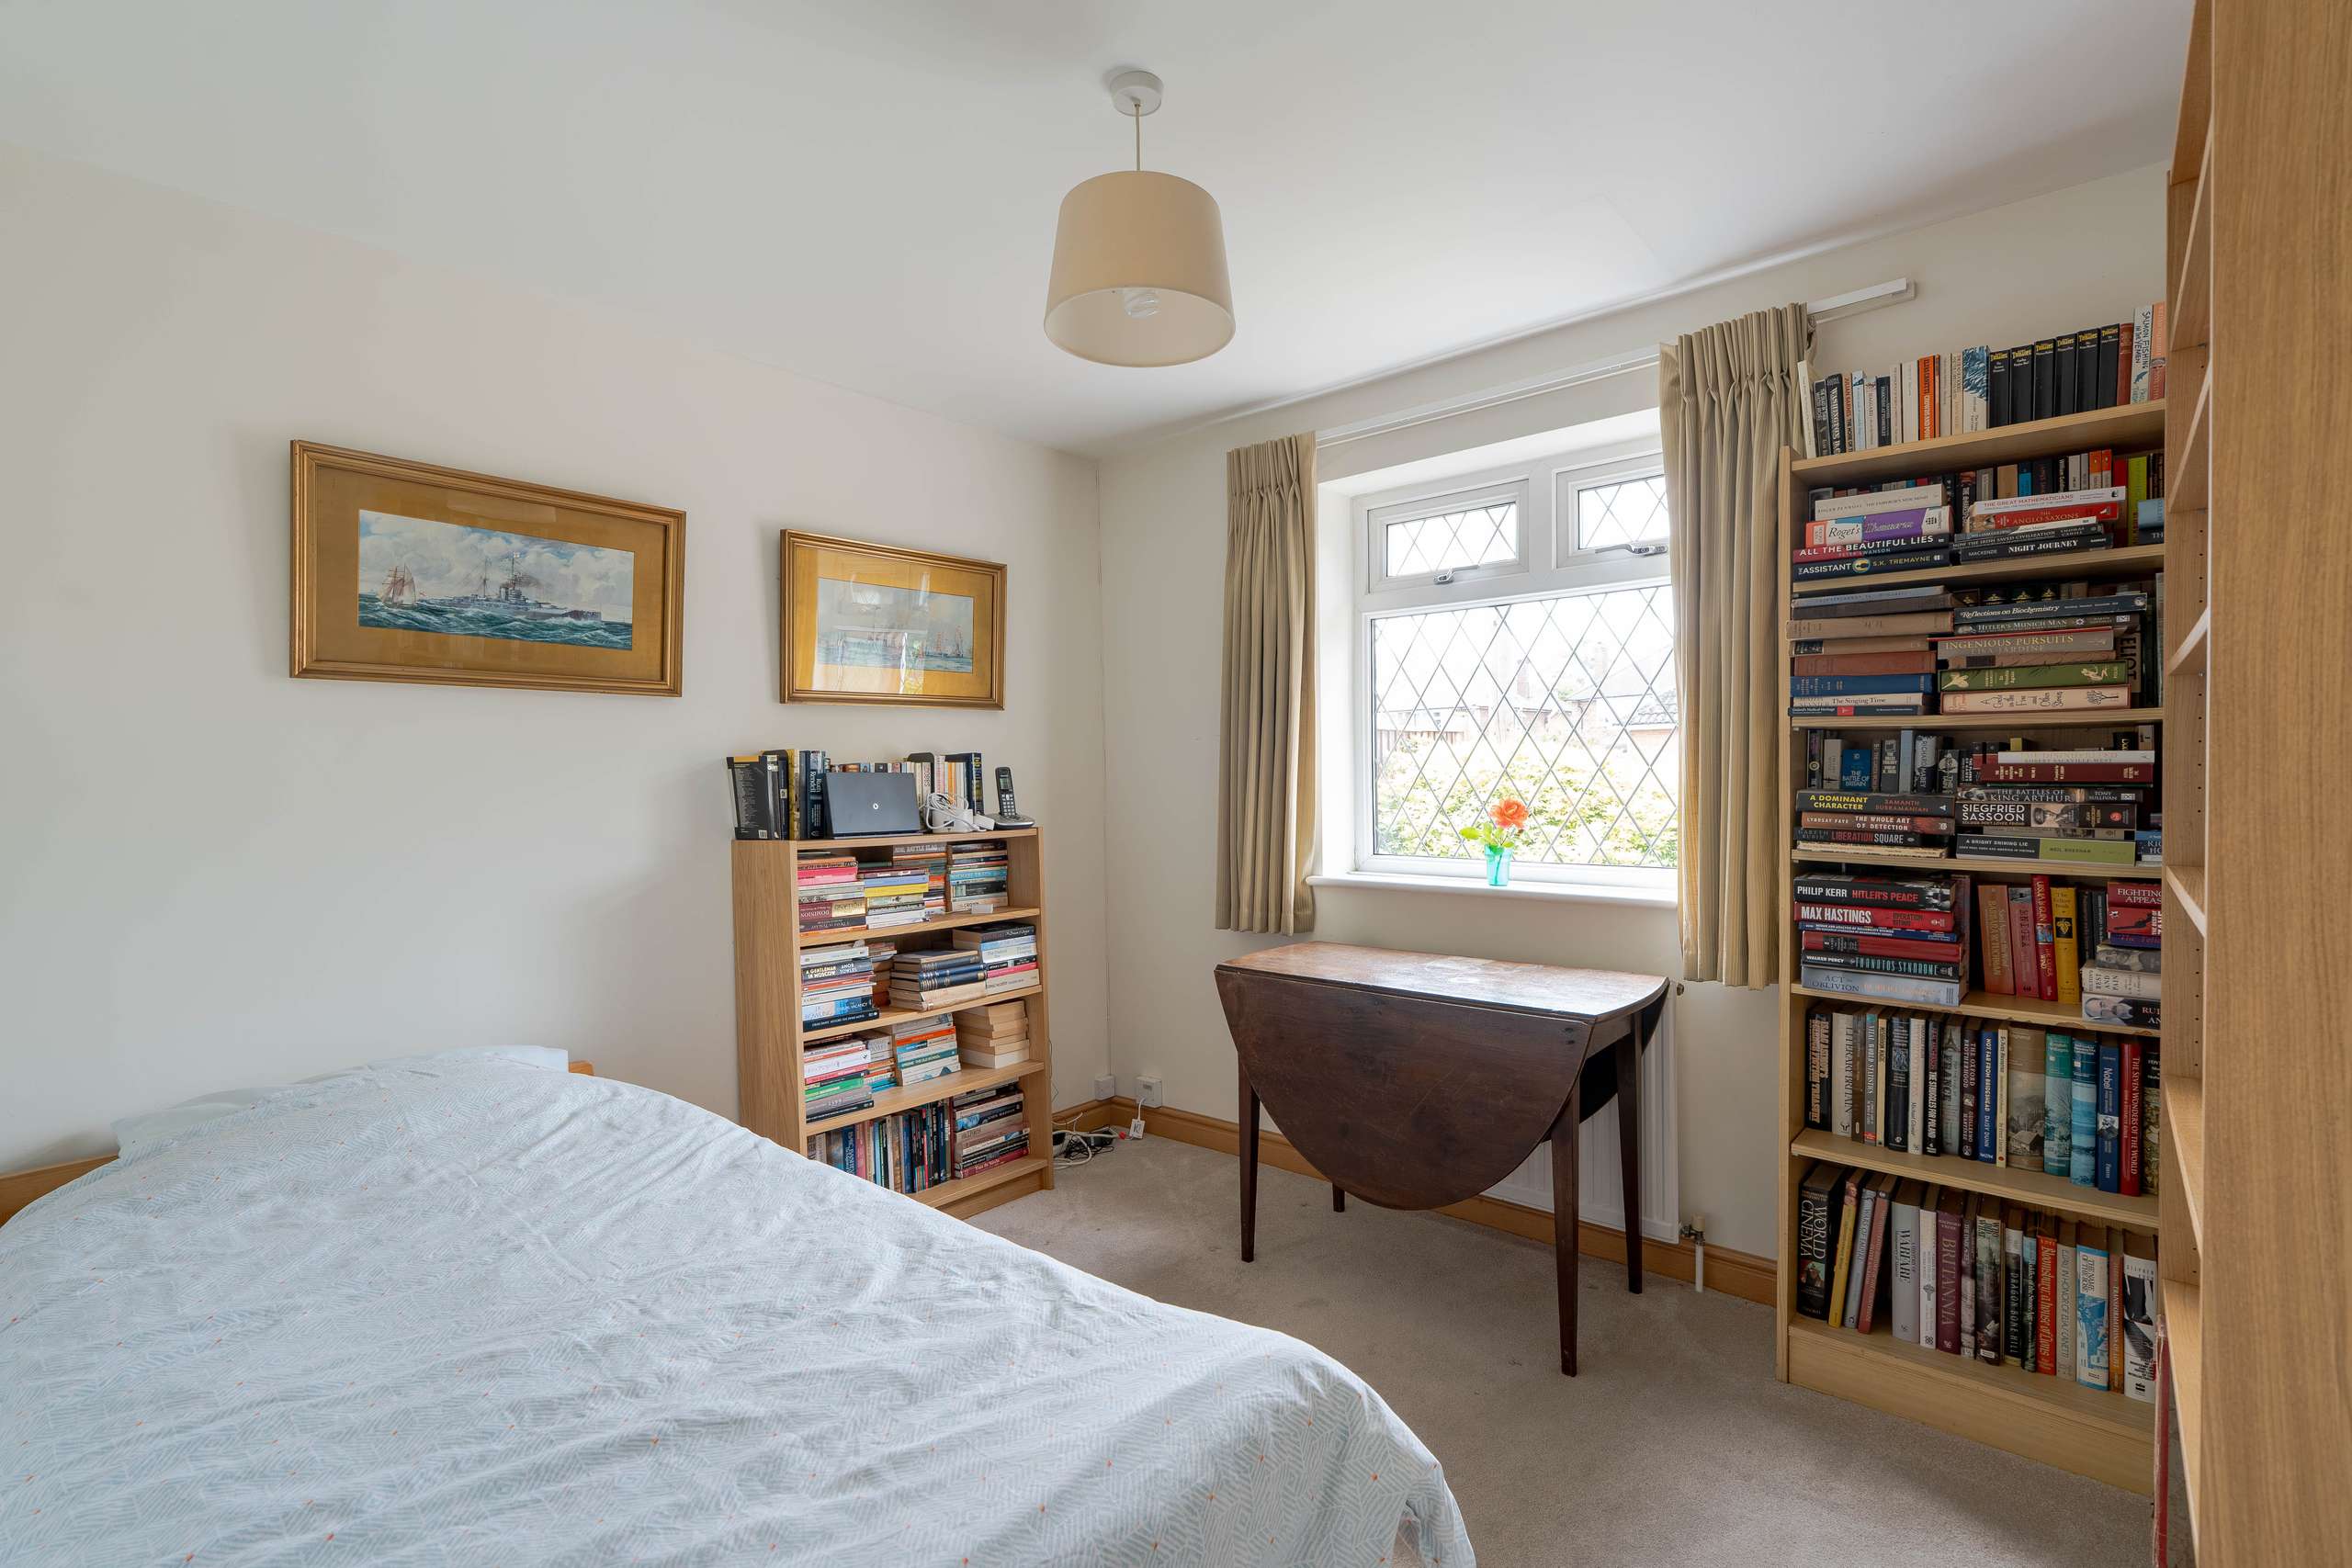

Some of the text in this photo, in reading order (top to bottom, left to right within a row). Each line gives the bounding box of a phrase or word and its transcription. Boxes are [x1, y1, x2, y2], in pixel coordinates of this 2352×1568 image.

[2142, 311, 2150, 369] SALMON FISHING
[2018, 494, 2074, 504] MATHEMATICIANS
[1828, 525, 1860, 539] Roget's
[1799, 535, 1934, 557] ALL THE BEAUTIFUL LIES
[2008, 544, 2034, 553] NIGHT
[2036, 540, 2078, 550] JOURNEY
[1803, 563, 1851, 575] ASSISTANT
[1889, 556, 1931, 565] TREMAYNE
[1961, 608, 1999, 619] Reflections
[2012, 604, 2060, 615] Biochemistry
[1978, 623, 2012, 631] HITLER'S
[2014, 620, 2047, 628] MUNICH
[1946, 636, 2074, 650] INGENIOUS PURSUITS
[2120, 637, 2137, 680] ELIOT
[1814, 802, 1863, 810] CHARACTER
[1819, 795, 1869, 803] DOMINANT
[1962, 804, 2025, 813] SIEGFRIED
[1962, 813, 2025, 821] SASSOON
[1870, 823, 1908, 831] DETECTION
[1831, 830, 1904, 844] LIBERATION SQUARE
[1797, 886, 1918, 902] PHILIP KERR HITLER'S PEACE
[1801, 906, 1871, 924] MAX HASTINGS
[1899, 960, 1939, 976] SYNDROME
[1812, 980, 1860, 992] OBLIVION
[1867, 1025, 1875, 1095] VITAL WORLD STATISTICS
[1928, 1071, 1937, 1080] THE
[1942, 1055, 1951, 1102] FRANCE
[2103, 1067, 2113, 1089] Nobel
[1812, 1083, 1821, 1123] TREASURY
[1928, 1109, 1937, 1118] FOR
[2131, 1057, 2141, 1175] THE SEVEN WONDERS OF THE WORLD
[1928, 1119, 1937, 1139] POLAND
[1801, 1200, 1814, 1257] CINEMA
[1813, 1205, 1827, 1259] WORLD
[1858, 1208, 1870, 1263] WARS OF EMPIRE
[1899, 1230, 1911, 1282] WARFARE
[1941, 1237, 1956, 1326] BRITANNIA
[2009, 1272, 2019, 1353] DRAGON BONE HILL
[2040, 1303, 2054, 1325] house
[2038, 1325, 2054, 1334] of
